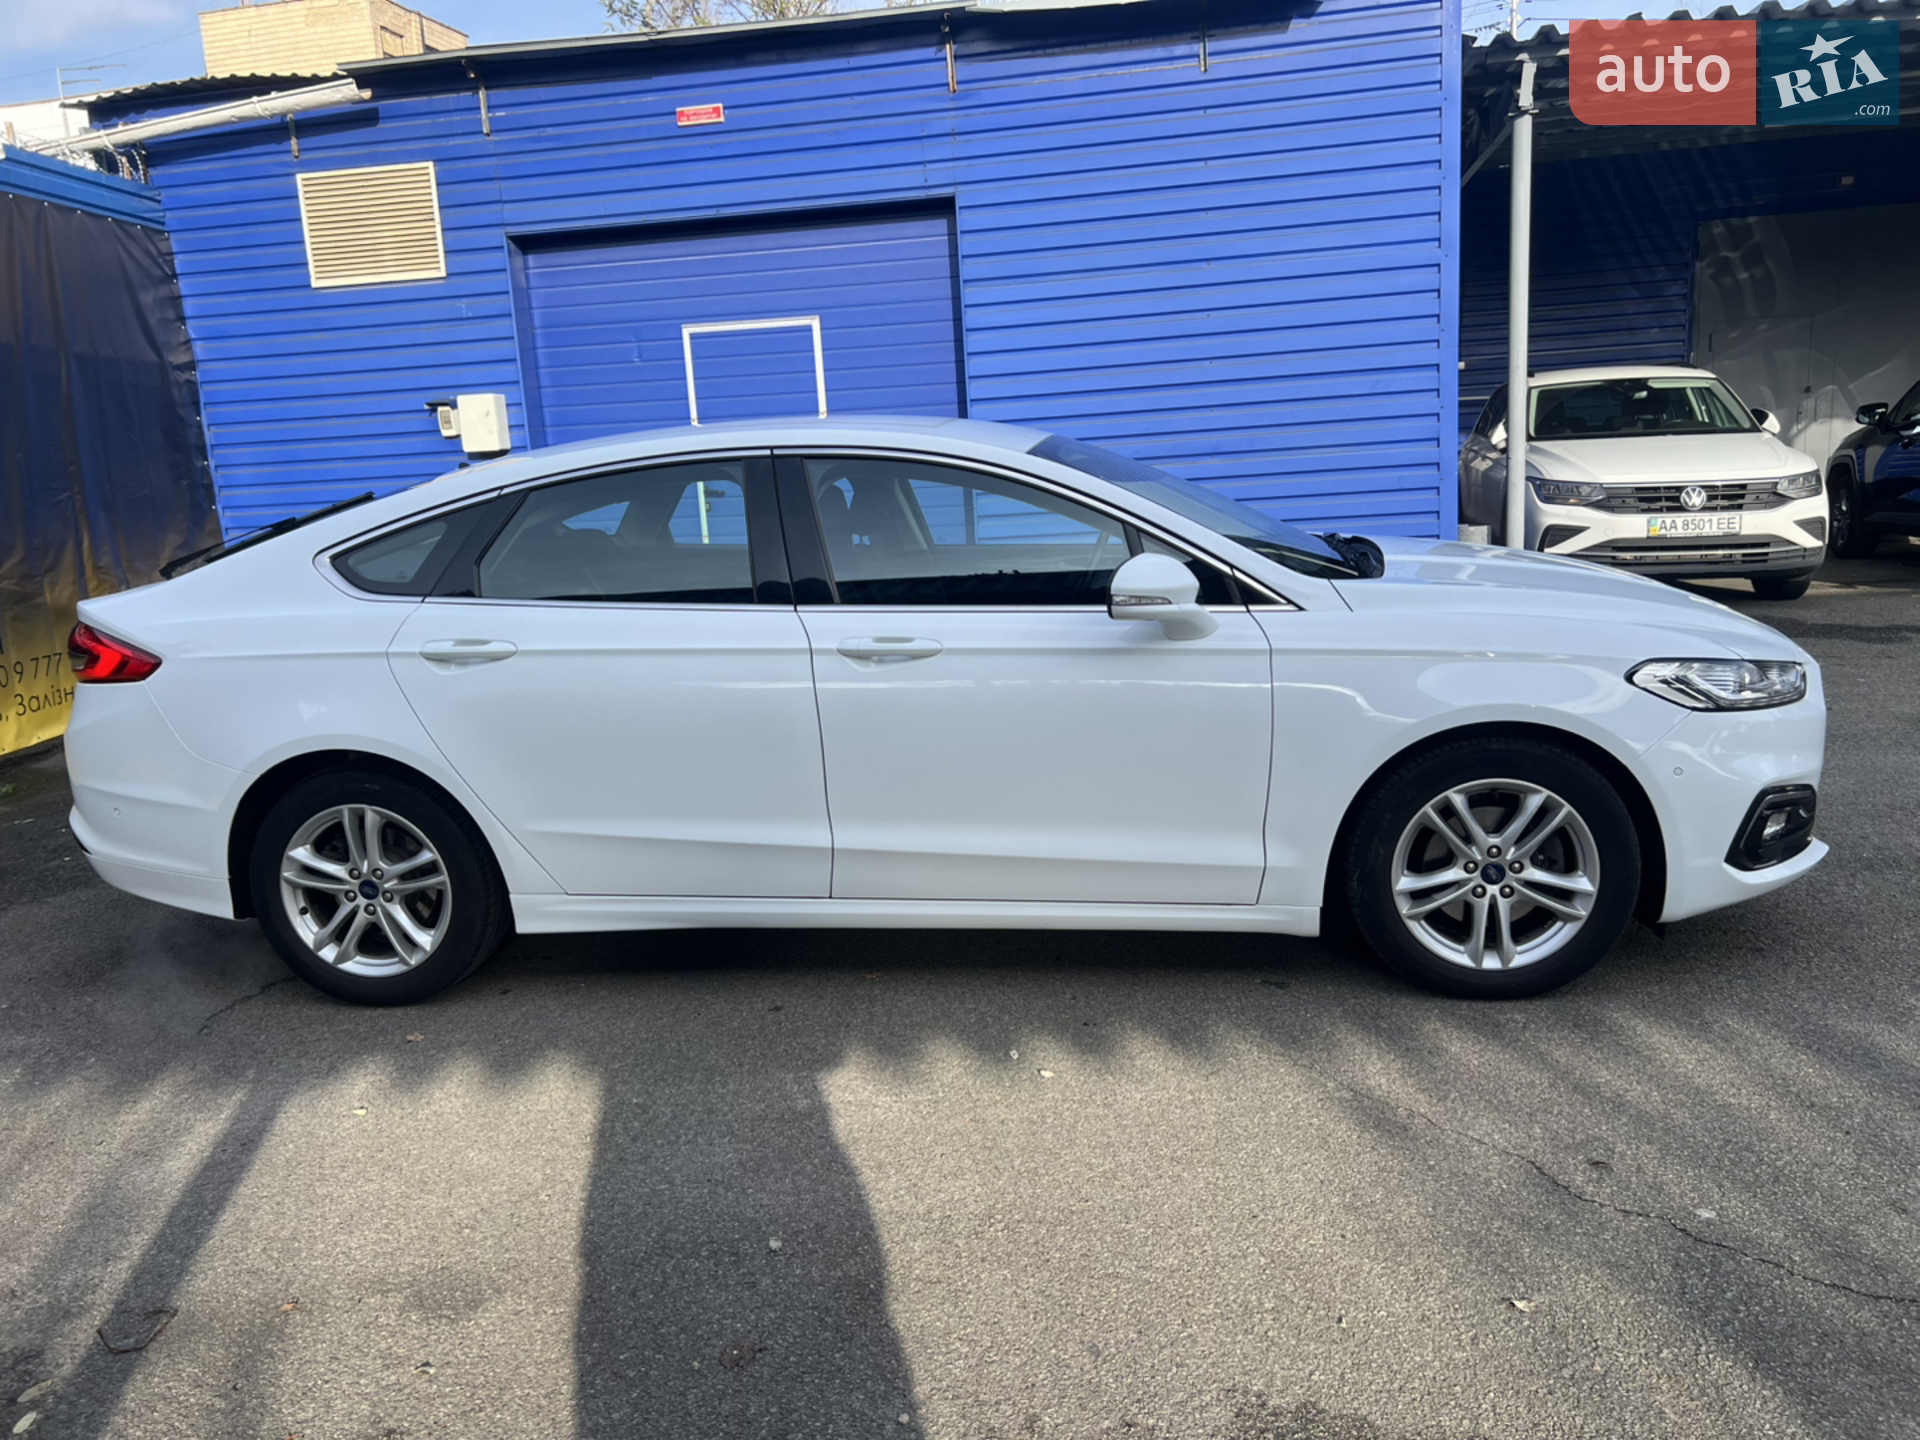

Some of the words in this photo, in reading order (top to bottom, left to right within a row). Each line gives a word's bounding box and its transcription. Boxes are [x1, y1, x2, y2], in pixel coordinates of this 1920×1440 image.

[1658, 519, 1678, 533] AA
[1681, 518, 1713, 532] 8501
[1717, 516, 1737, 530] EE
[30, 652, 62, 680] 777
